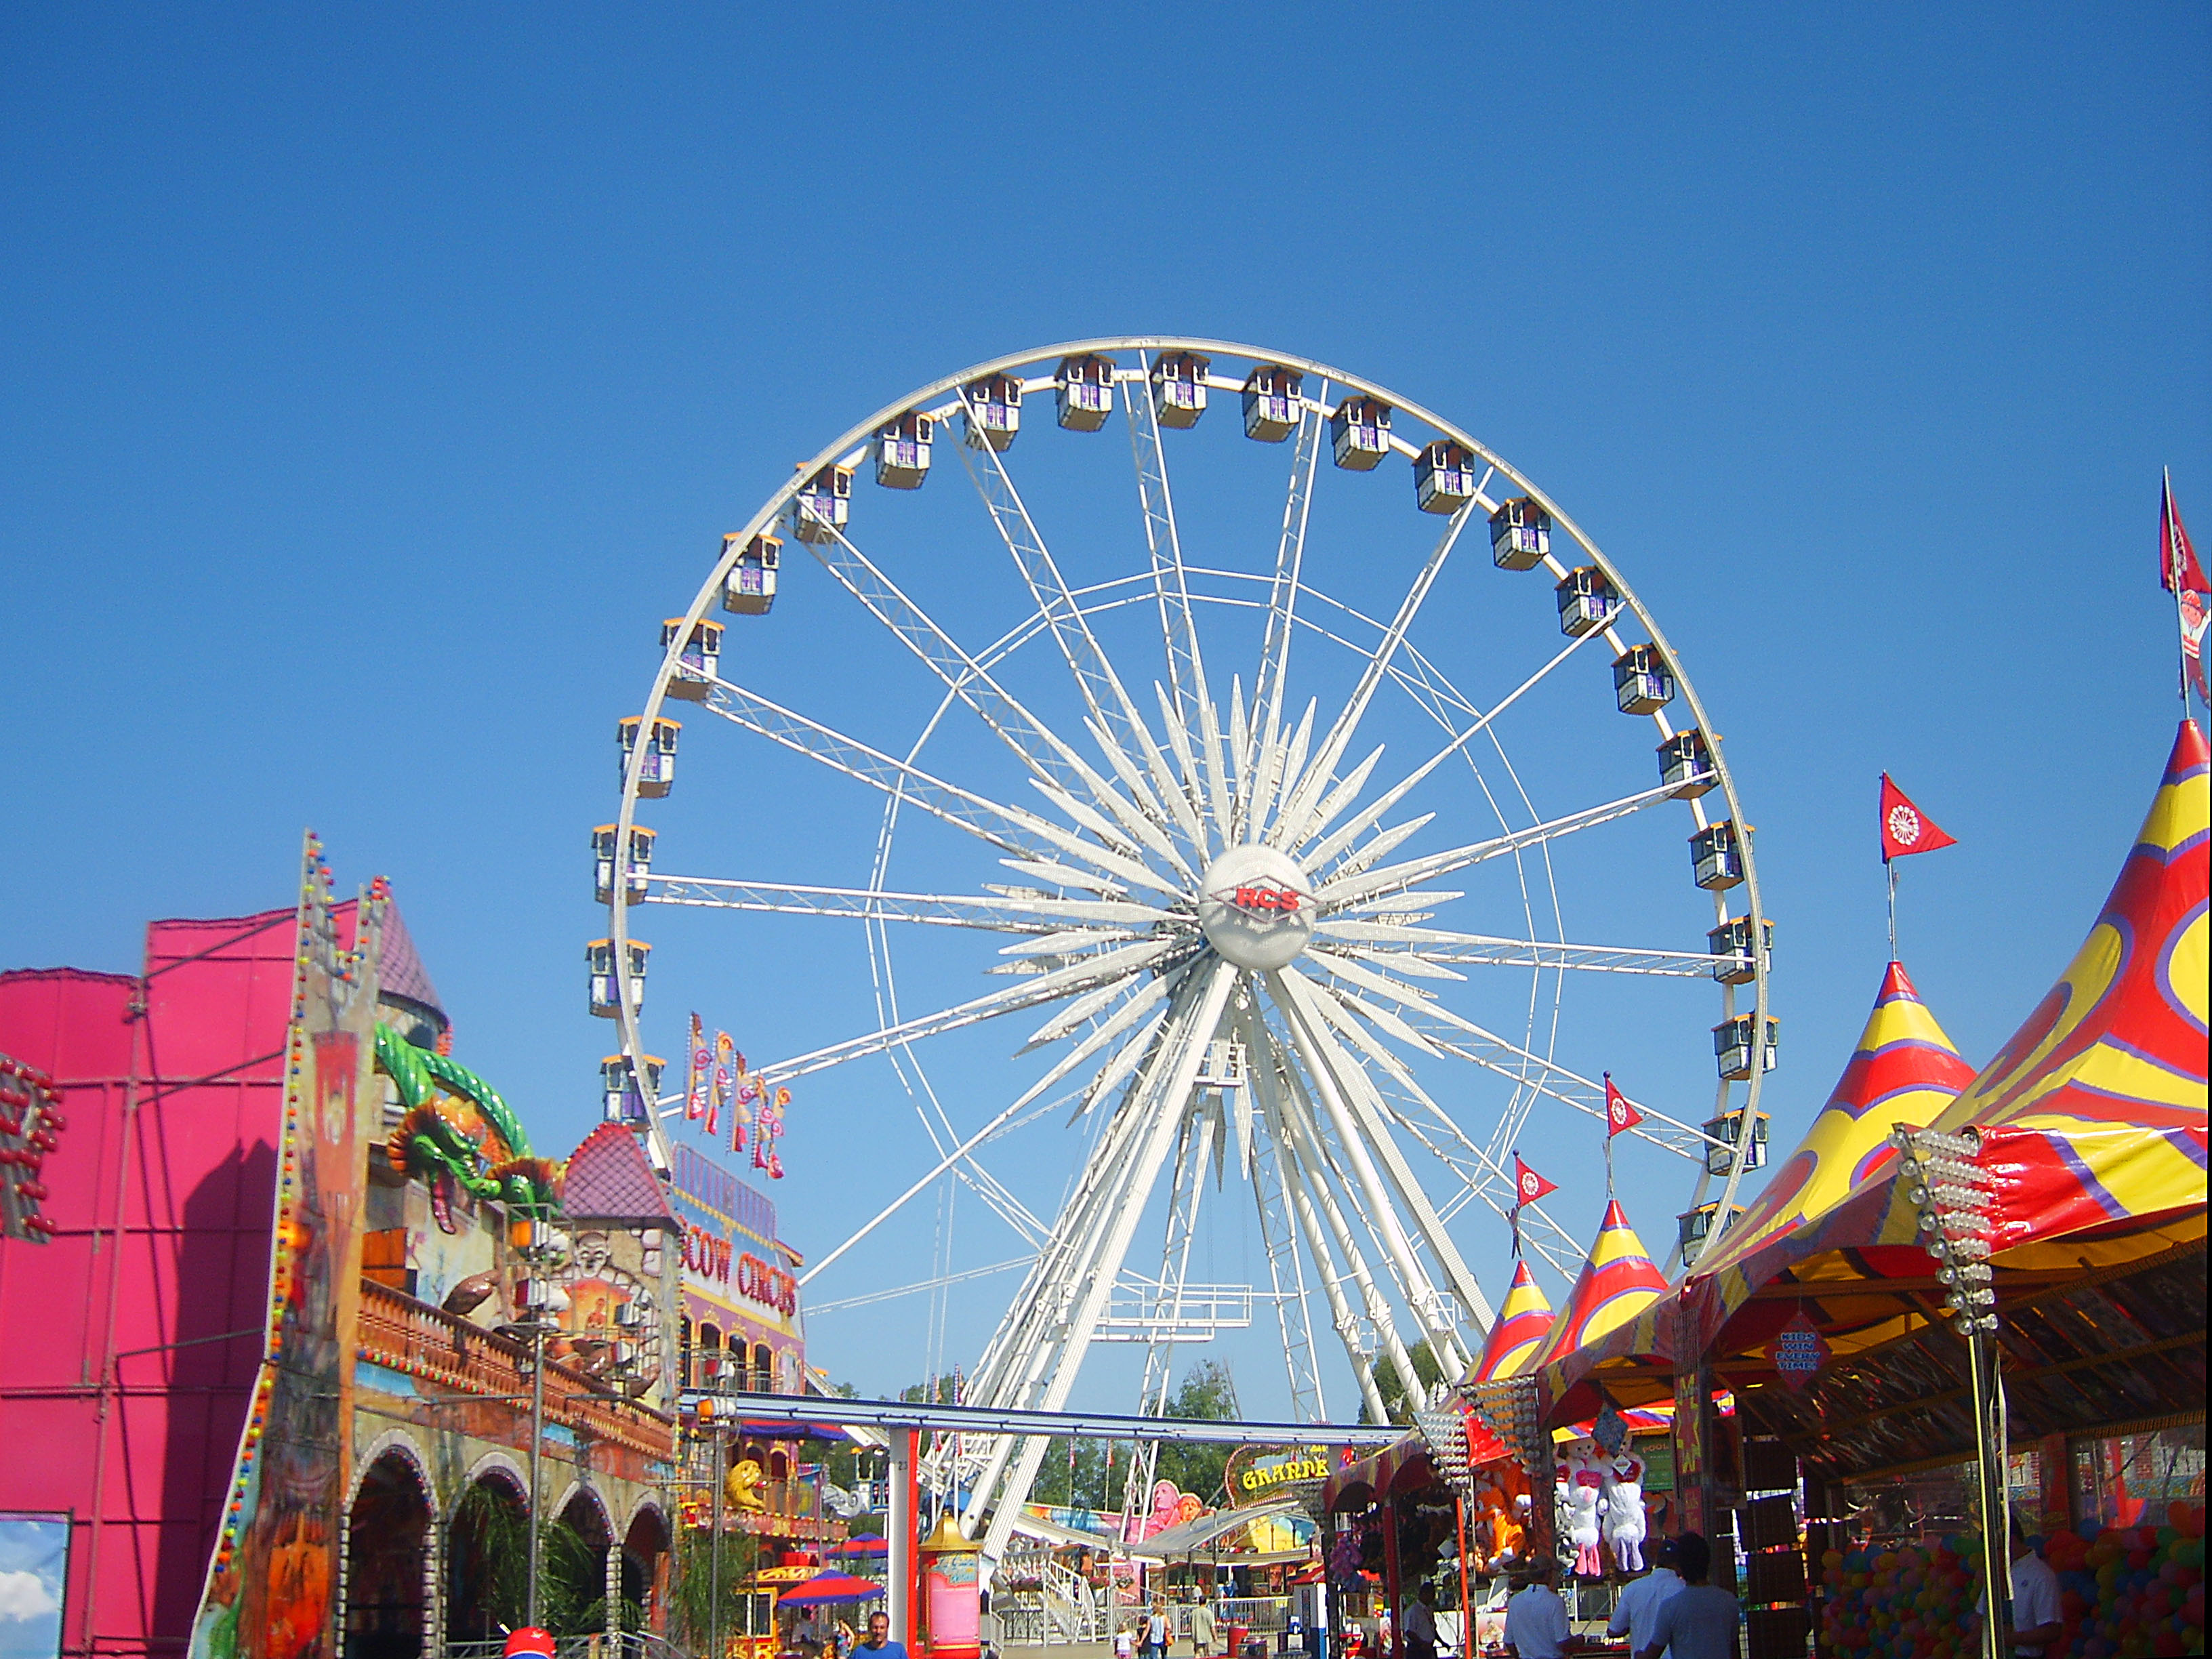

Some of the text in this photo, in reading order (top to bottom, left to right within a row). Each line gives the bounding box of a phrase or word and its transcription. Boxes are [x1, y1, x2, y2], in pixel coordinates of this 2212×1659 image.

[1236, 888, 1299, 911] RCS
[737, 1251, 796, 1317] CIRCUS
[1781, 1332, 1816, 1341] KIDS
[1782, 1342, 1814, 1351] WIN
[1776, 1351, 1820, 1360] EVERY
[1642, 1443, 1668, 1453] POOL
